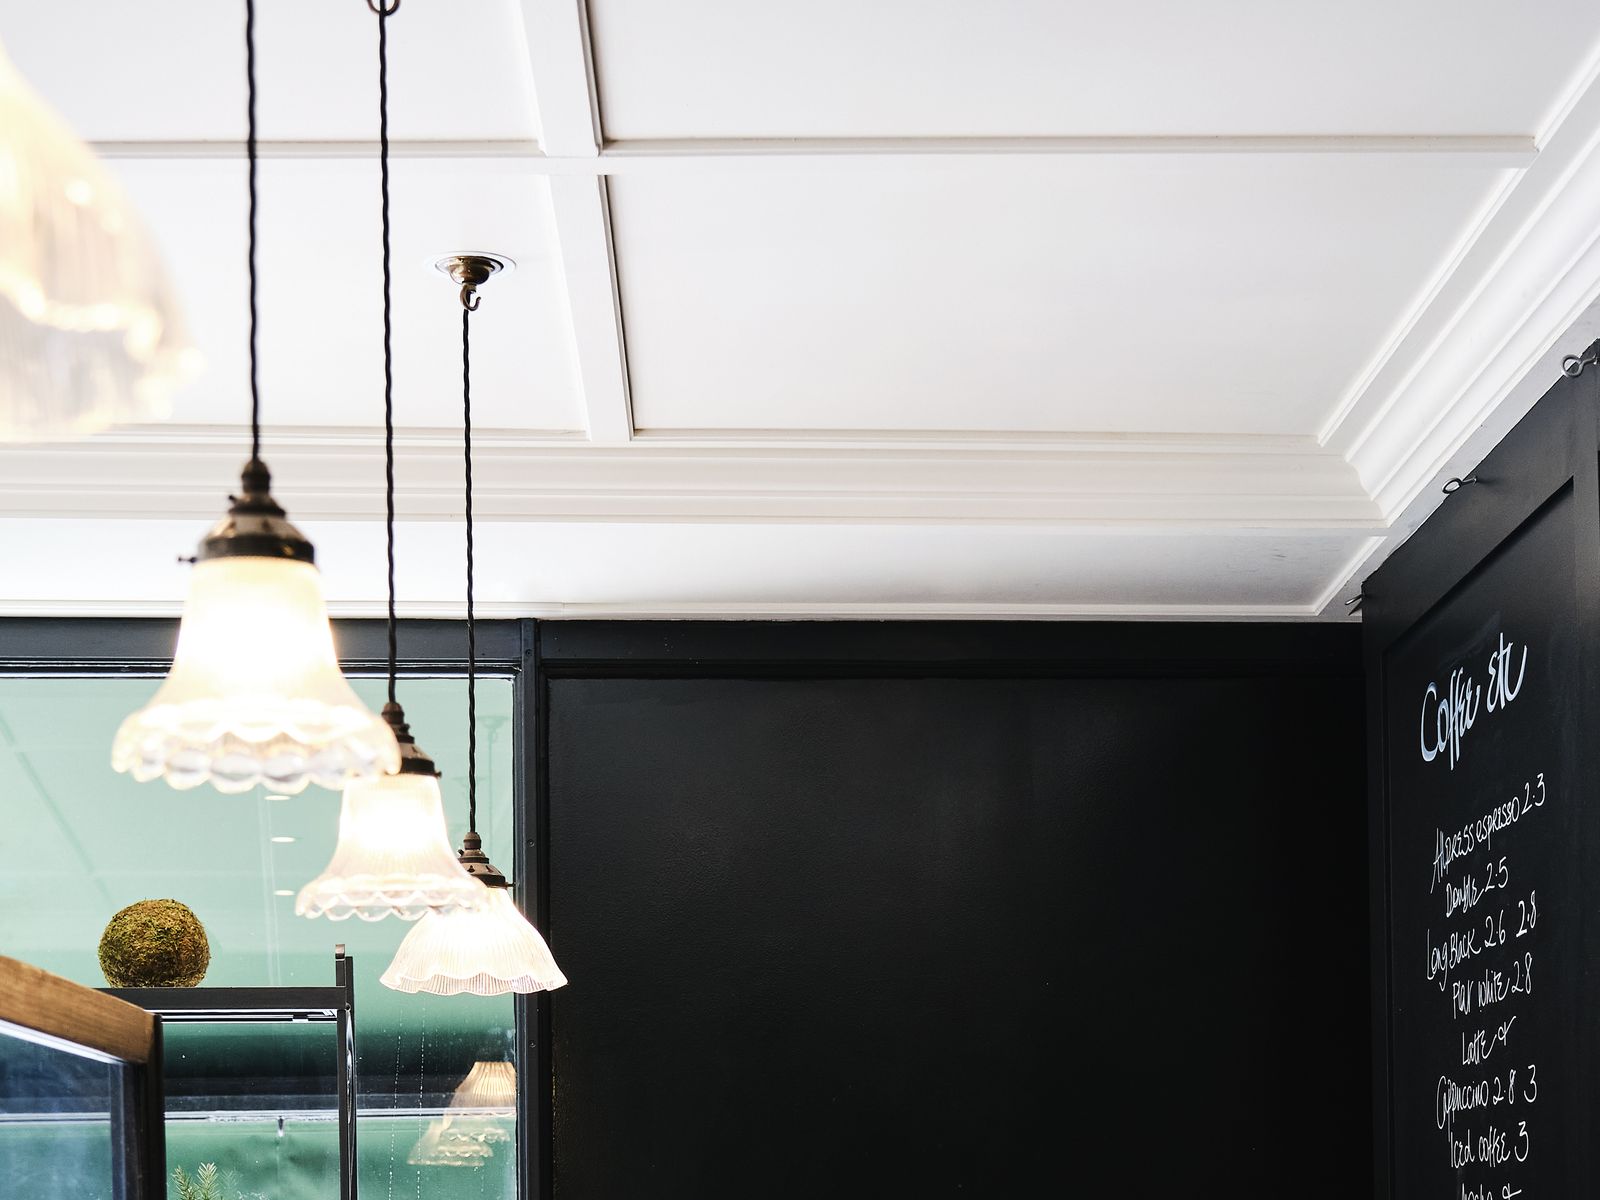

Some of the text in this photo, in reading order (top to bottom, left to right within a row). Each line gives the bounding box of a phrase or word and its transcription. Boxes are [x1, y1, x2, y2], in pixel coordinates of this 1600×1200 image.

[1420, 667, 1481, 771] Coffee
[1521, 773, 1546, 815] 2.3
[1485, 856, 1509, 892] 2.5
[1484, 909, 1506, 948] 2.6
[1516, 890, 1537, 938] 2.8
[1511, 951, 1533, 994] 2.8
[1493, 1069, 1517, 1105] 2.8
[1523, 1064, 1538, 1103] 3
[1514, 1121, 1529, 1162] 3
